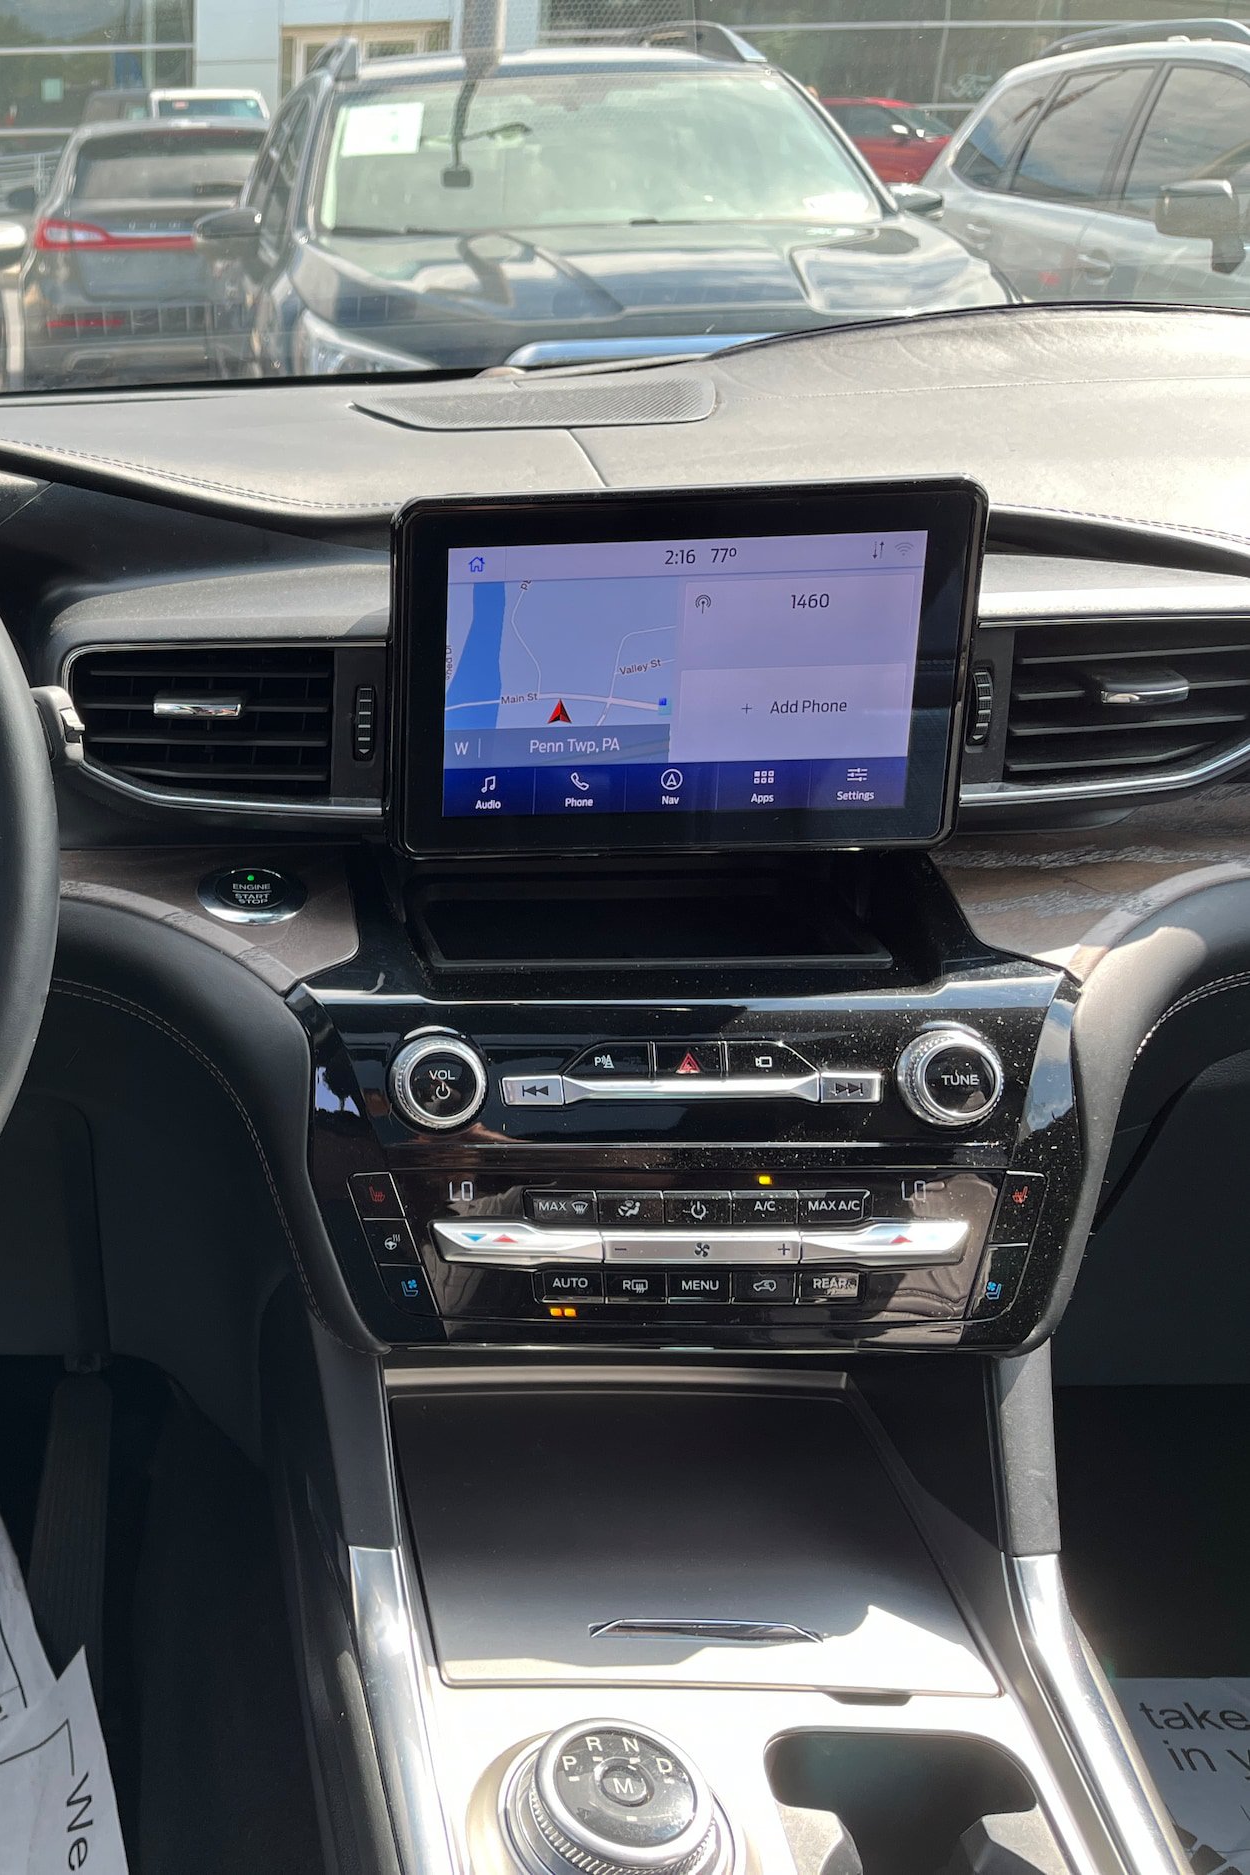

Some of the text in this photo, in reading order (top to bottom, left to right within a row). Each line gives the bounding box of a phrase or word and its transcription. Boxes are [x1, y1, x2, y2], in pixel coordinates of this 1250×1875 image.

[664, 549, 696, 565] 2:16
[790, 593, 830, 609] 1460
[619, 659, 661, 675] Valley St
[501, 693, 538, 704] Main St
[770, 700, 848, 714] Add Phone
[454, 741, 469, 756] W
[529, 737, 620, 754] Penn Twp, PA
[565, 797, 593, 808] Phone
[661, 795, 680, 805] Nav
[751, 793, 774, 804] Apps
[836, 790, 875, 802] Settings
[475, 799, 501, 810] Audio
[428, 1069, 455, 1080] VOL
[941, 1074, 980, 1085] TUNE
[449, 1181, 473, 1201] LO
[902, 1180, 926, 1200] LO
[538, 1202, 567, 1211] MAX
[754, 1201, 776, 1211] A/C
[808, 1200, 861, 1211] MAX A/C
[552, 1278, 589, 1288] AUTO
[681, 1280, 719, 1290] MENU
[813, 1278, 848, 1289] REAR
[1139, 1702, 1250, 1731] take
[586, 1736, 603, 1752] R
[622, 1737, 641, 1752] N
[1162, 1739, 1217, 1772] in
[562, 1755, 577, 1771] P
[655, 1757, 673, 1775] D
[612, 1778, 635, 1794] M
[66, 1771, 93, 1871] We
